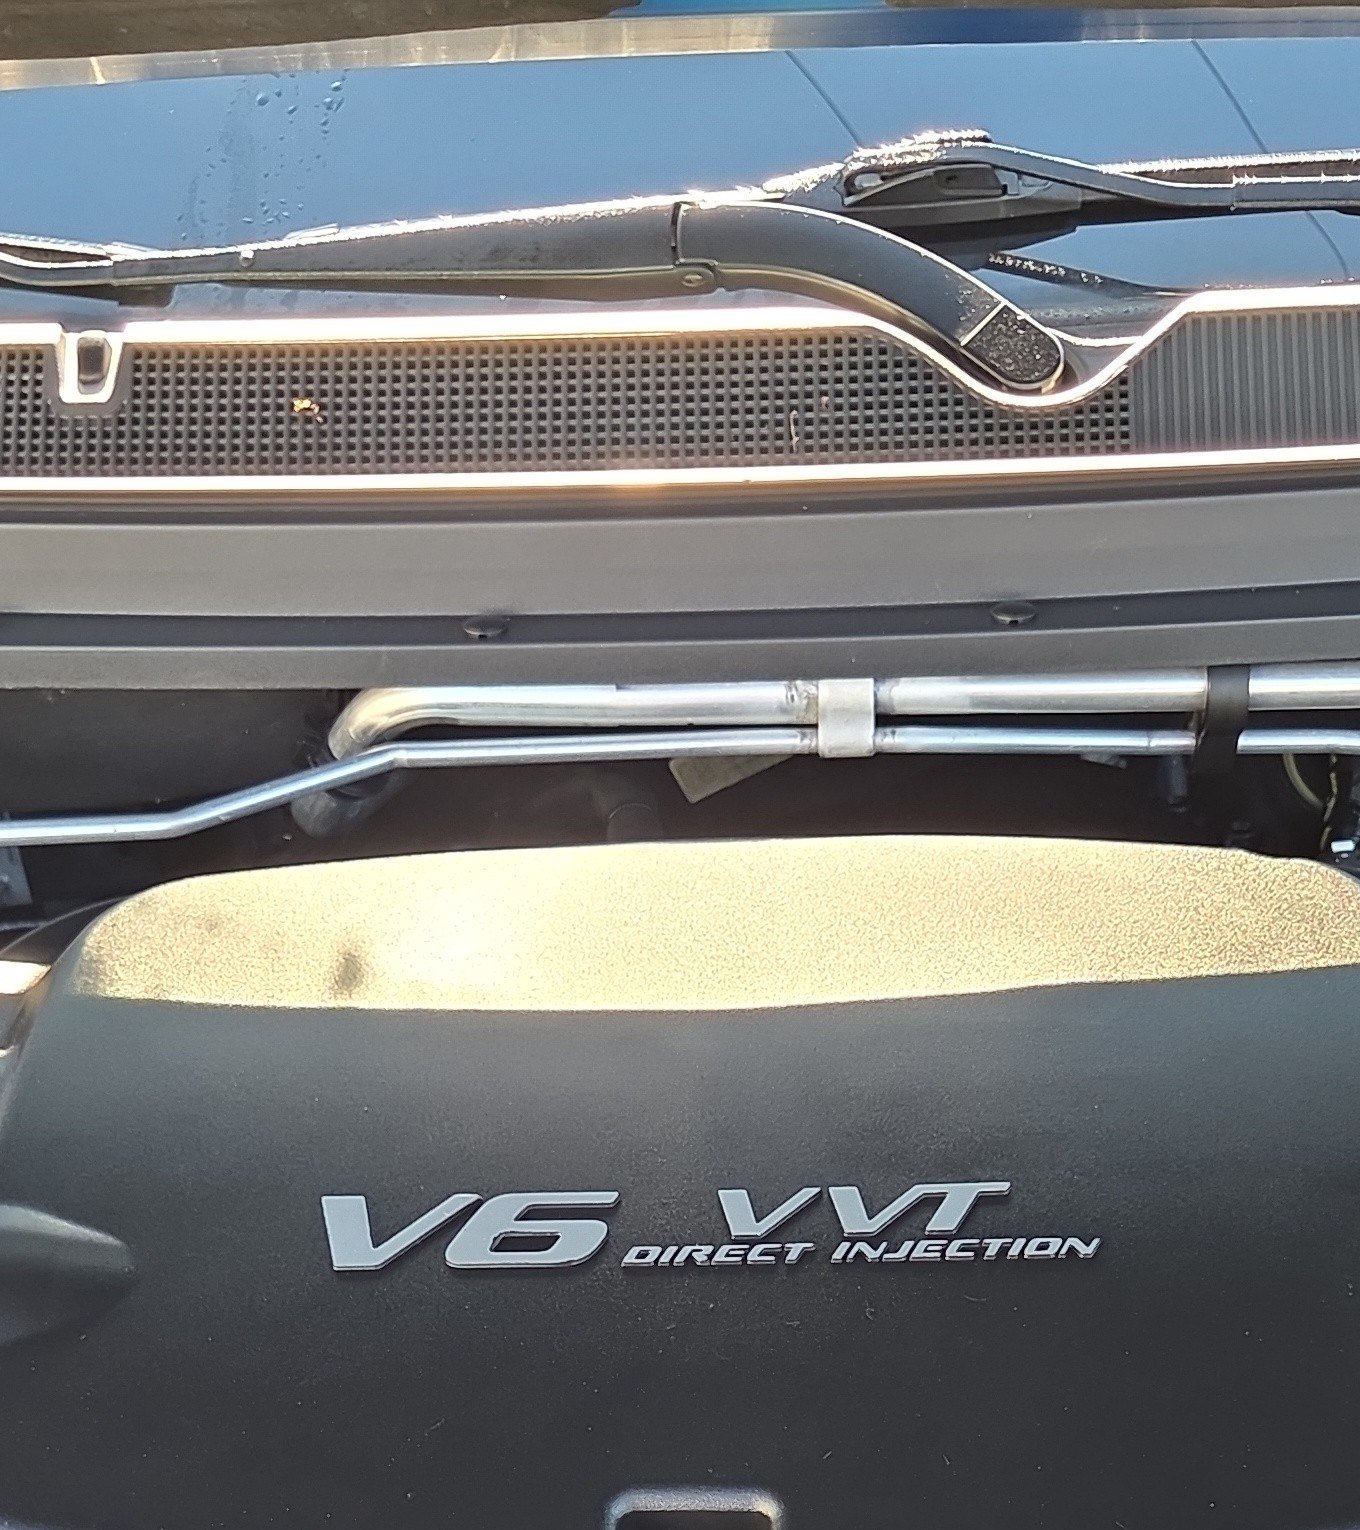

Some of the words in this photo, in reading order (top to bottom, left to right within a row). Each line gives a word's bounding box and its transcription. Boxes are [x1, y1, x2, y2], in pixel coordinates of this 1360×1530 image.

[319, 1190, 621, 1271] V6
[716, 1180, 1012, 1240] VVT
[620, 1242, 820, 1268] DIRECT
[830, 1236, 1102, 1266] INJECTION
